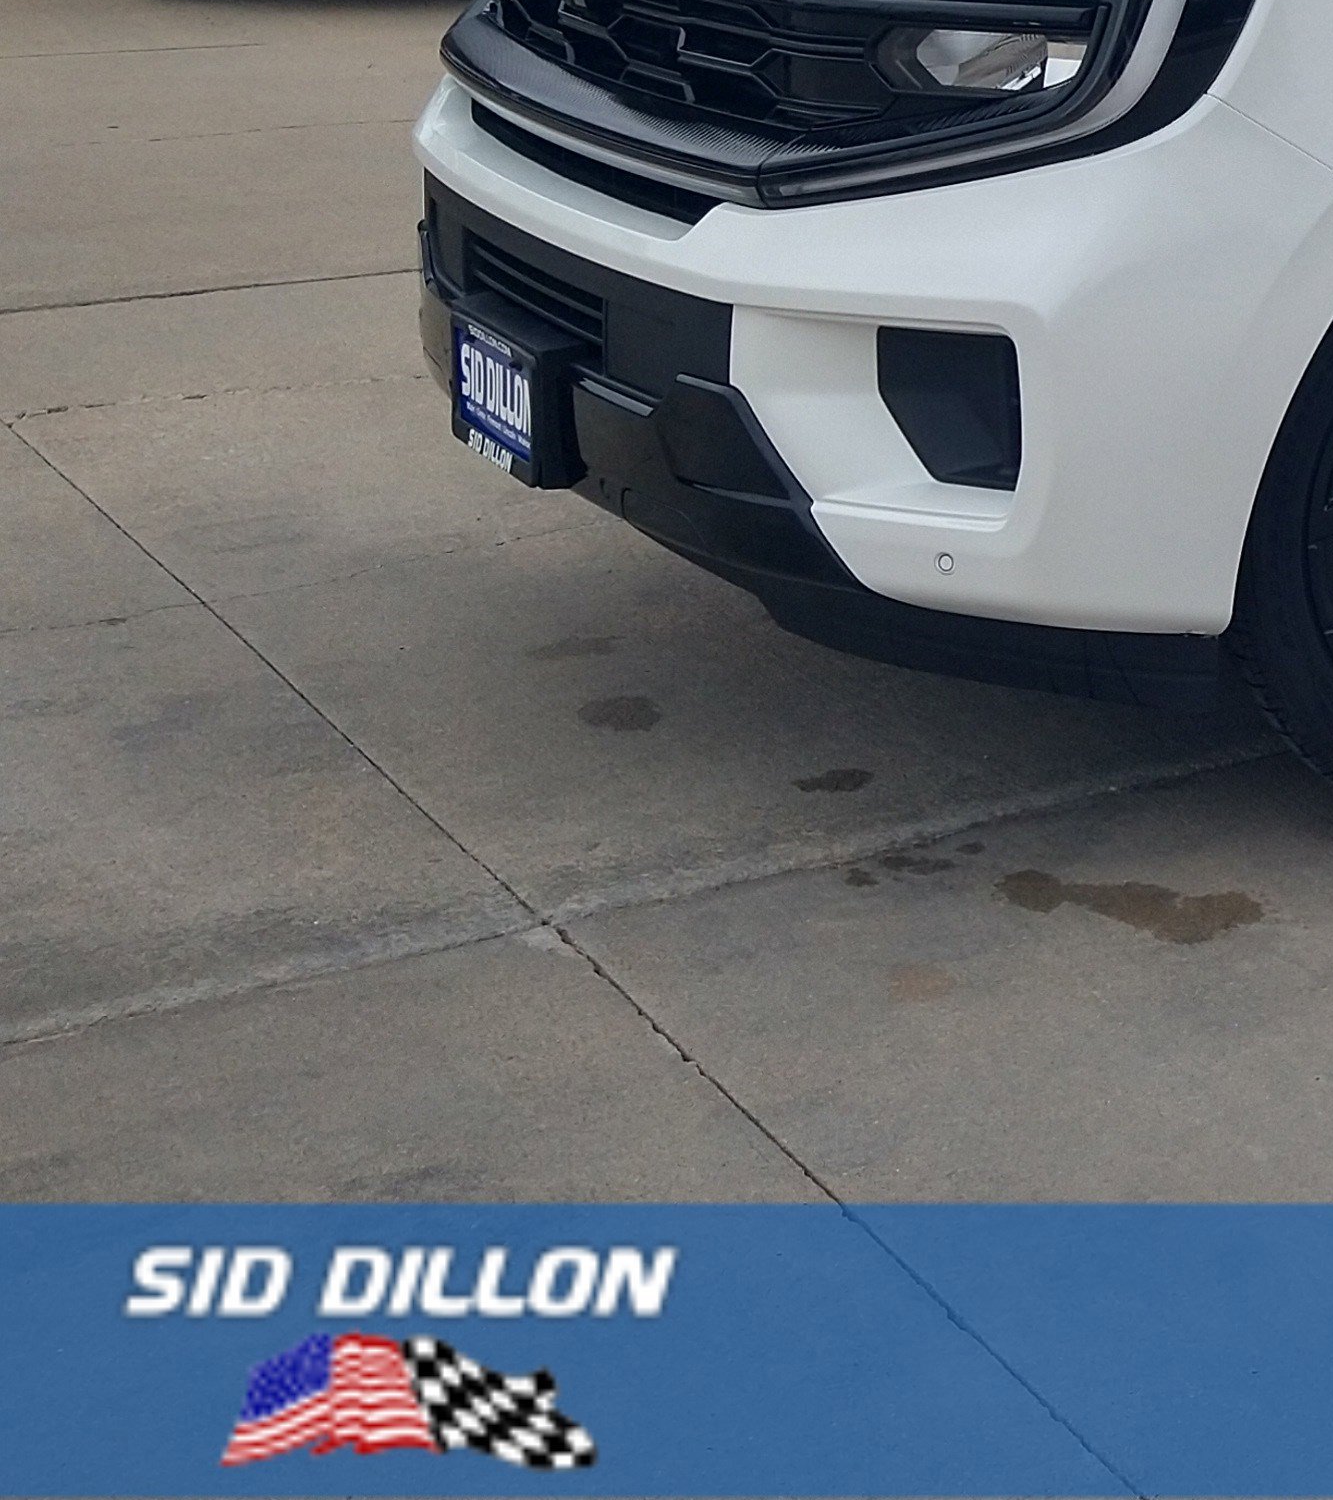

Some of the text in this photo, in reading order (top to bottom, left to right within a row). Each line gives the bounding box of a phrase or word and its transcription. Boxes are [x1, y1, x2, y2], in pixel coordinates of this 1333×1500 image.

[461, 343, 485, 405] SID
[486, 357, 532, 438] DILLON
[468, 428, 514, 474] SID DILLON
